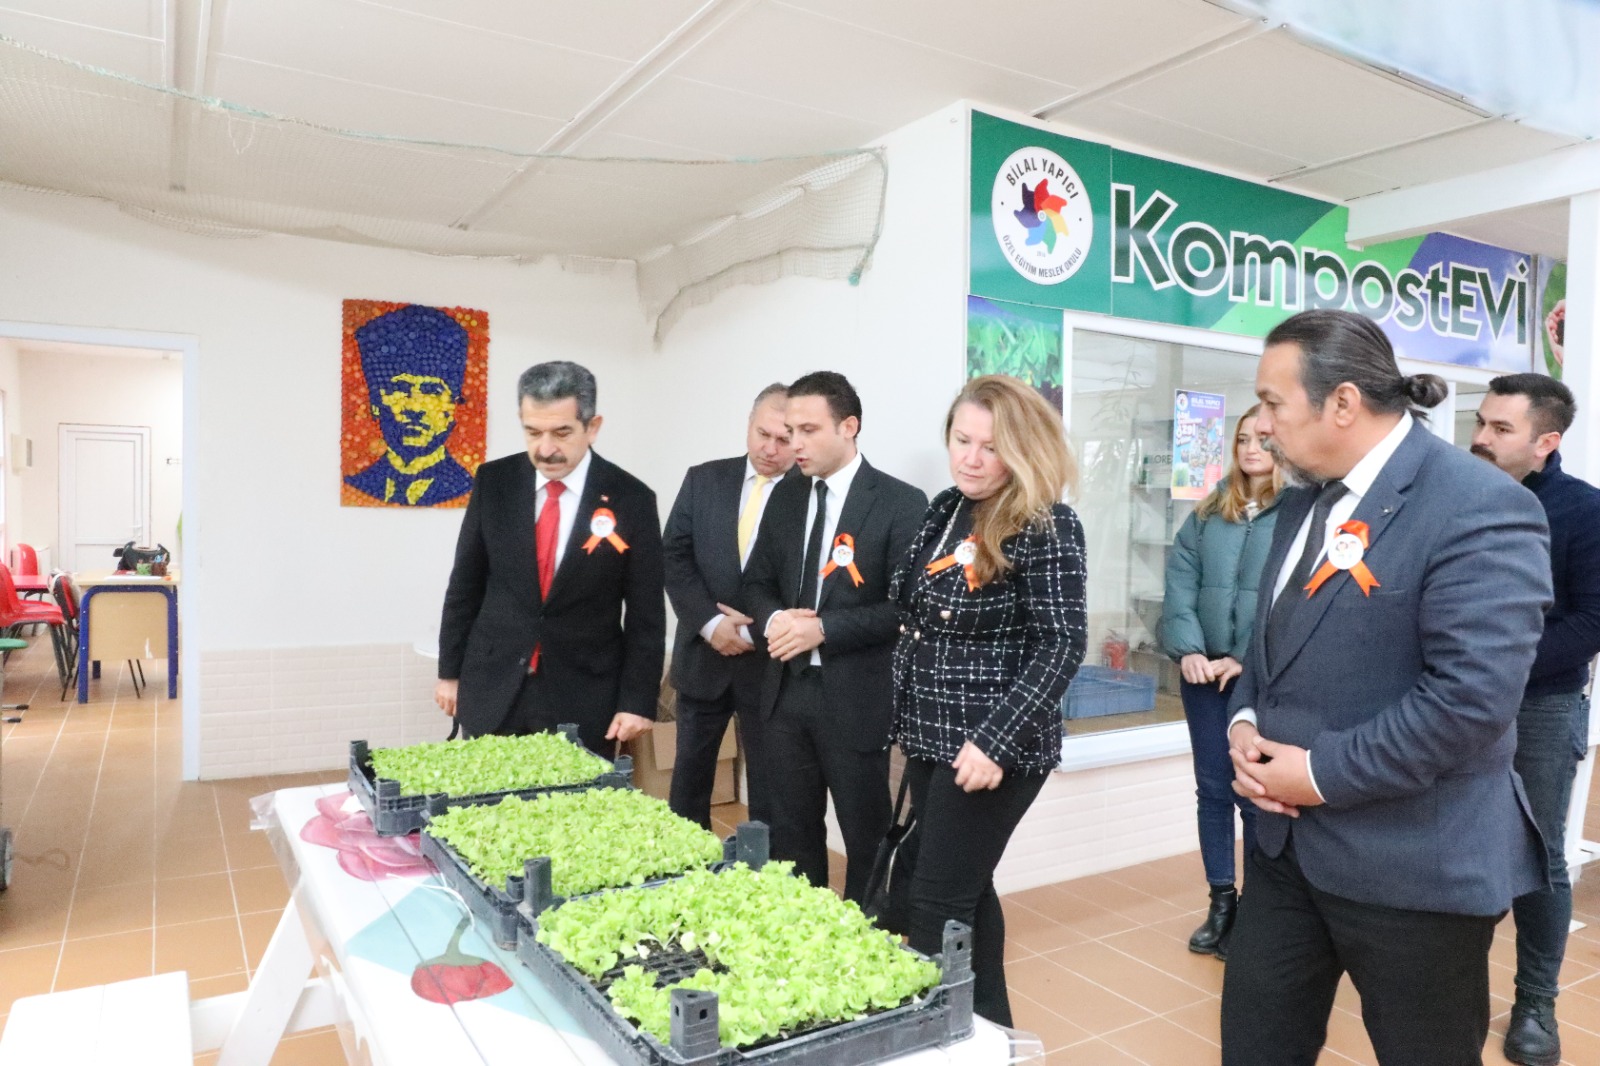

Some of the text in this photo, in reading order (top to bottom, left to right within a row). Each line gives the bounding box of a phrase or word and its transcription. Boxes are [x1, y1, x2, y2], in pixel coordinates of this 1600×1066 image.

[1006, 157, 1079, 199] BİLAL YAPICI
[1003, 235, 1082, 278] ÖZEL EĞİTİM MESLEK OKULU
